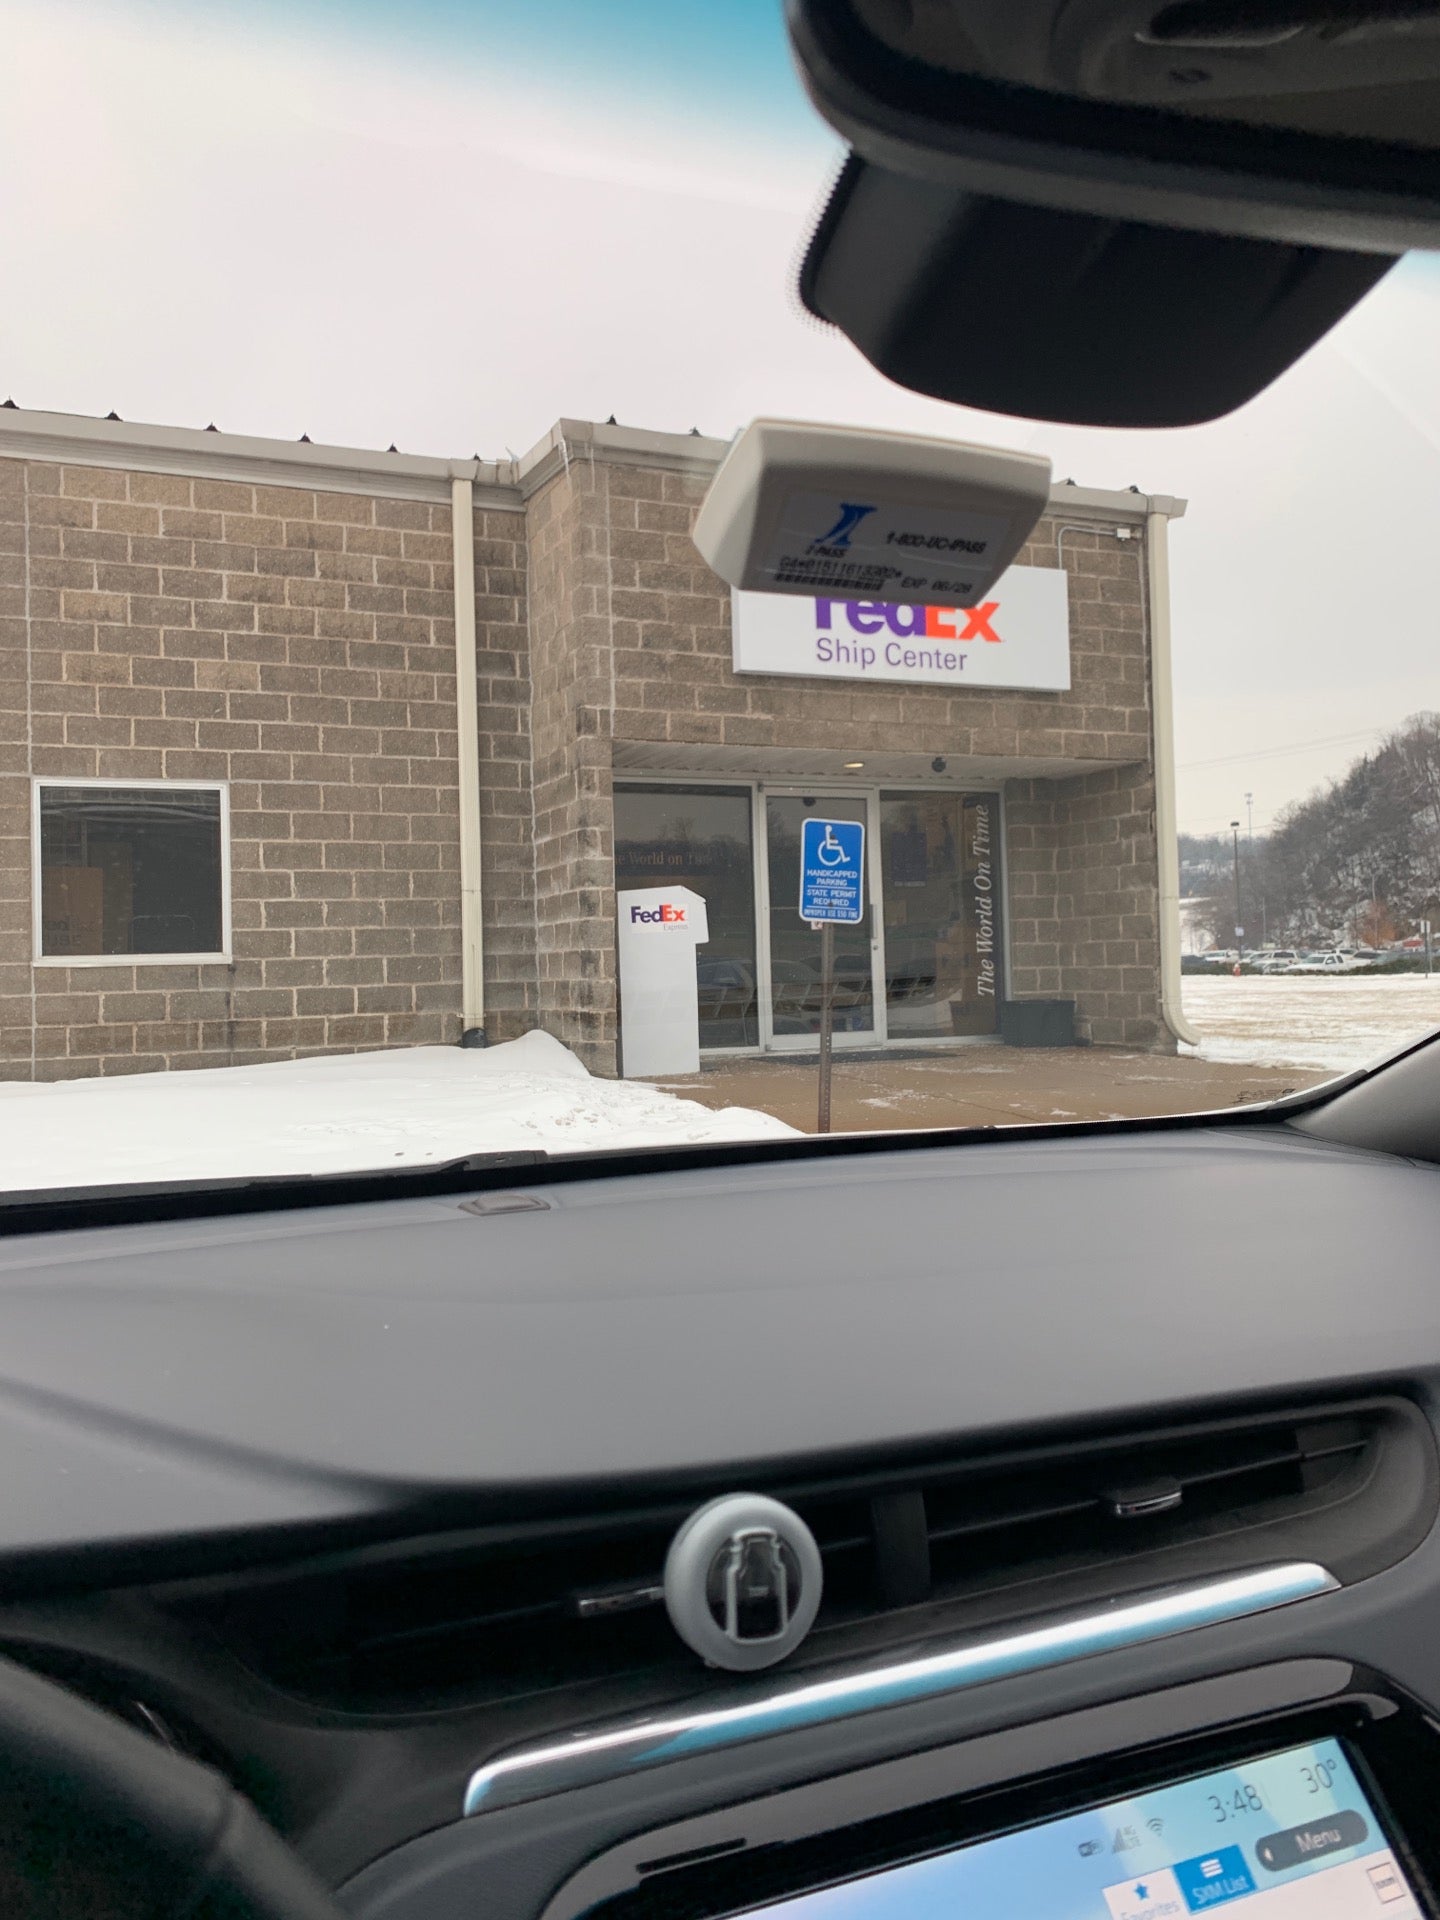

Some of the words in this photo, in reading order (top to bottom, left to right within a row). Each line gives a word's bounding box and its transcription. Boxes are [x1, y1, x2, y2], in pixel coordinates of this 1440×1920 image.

[901, 576, 927, 588] EXP
[817, 637, 876, 671] Ship
[885, 642, 968, 671] Center
[972, 804, 991, 857] Time
[628, 851, 664, 865] World
[667, 855, 683, 865] on
[806, 869, 858, 879] HANDICAPPED
[816, 878, 848, 886] PARKING
[973, 861, 993, 892] On
[807, 889, 828, 897] STATE
[830, 889, 857, 898] PERMIT
[813, 897, 850, 907] REQUIRED
[631, 903, 686, 924] FedEx
[975, 895, 994, 953] World
[978, 958, 996, 996] The
[1207, 1784, 1264, 1823] 3:48
[1295, 1826, 1342, 1853] Menu
[1192, 1880, 1223, 1906] SXM
[1227, 1874, 1250, 1895] List
